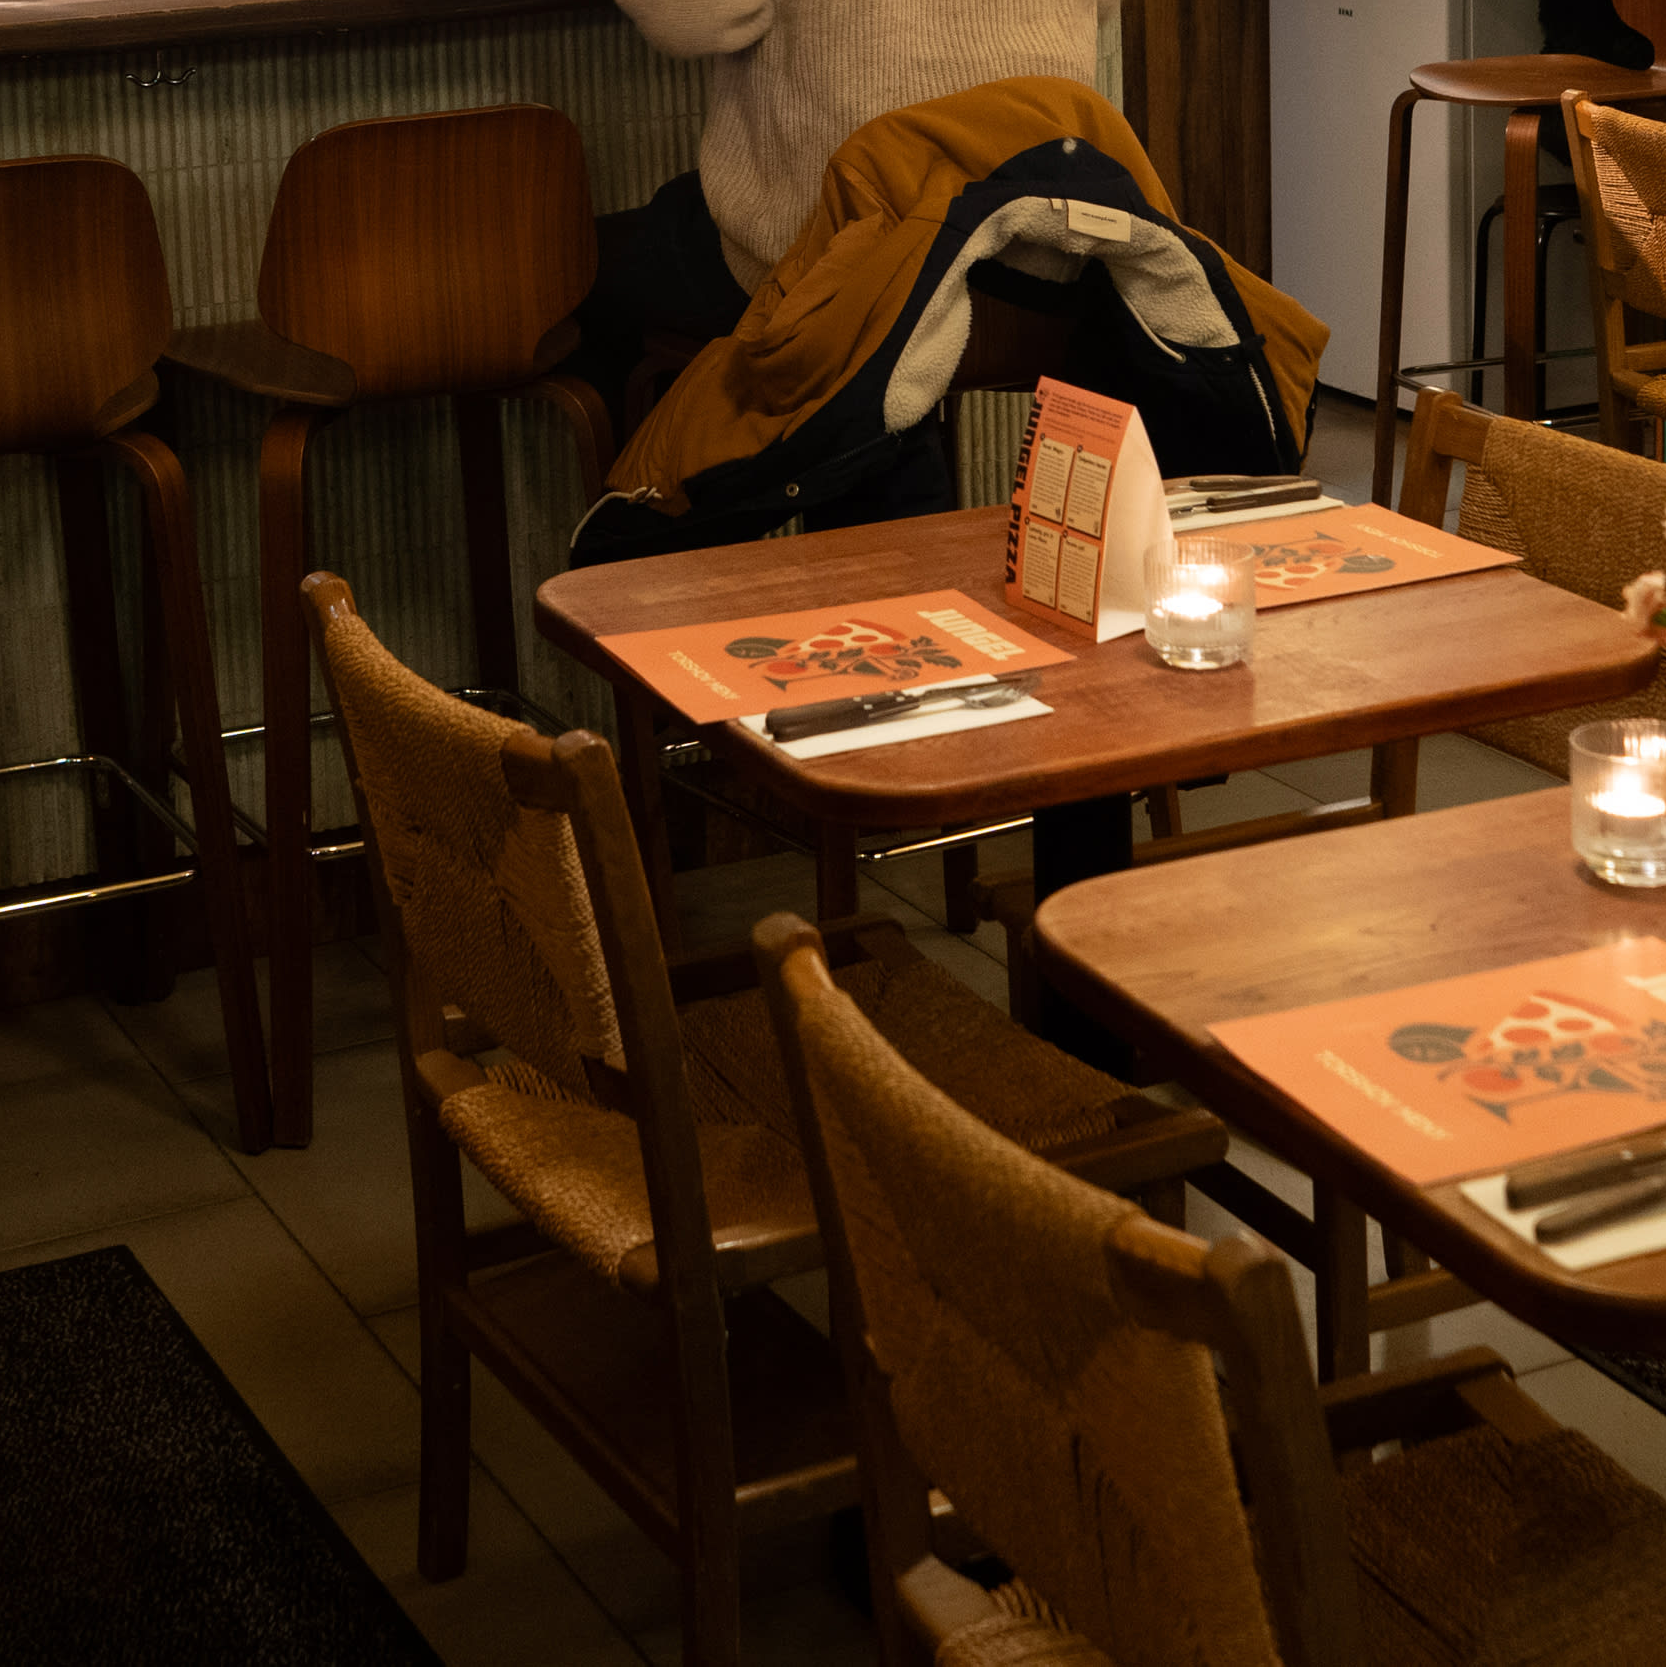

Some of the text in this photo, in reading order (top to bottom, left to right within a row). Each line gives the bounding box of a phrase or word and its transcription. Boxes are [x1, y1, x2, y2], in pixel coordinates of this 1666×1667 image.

[1005, 399, 1043, 584] JUNGEL PIZZA
[917, 609, 1026, 661] JUNGEL
